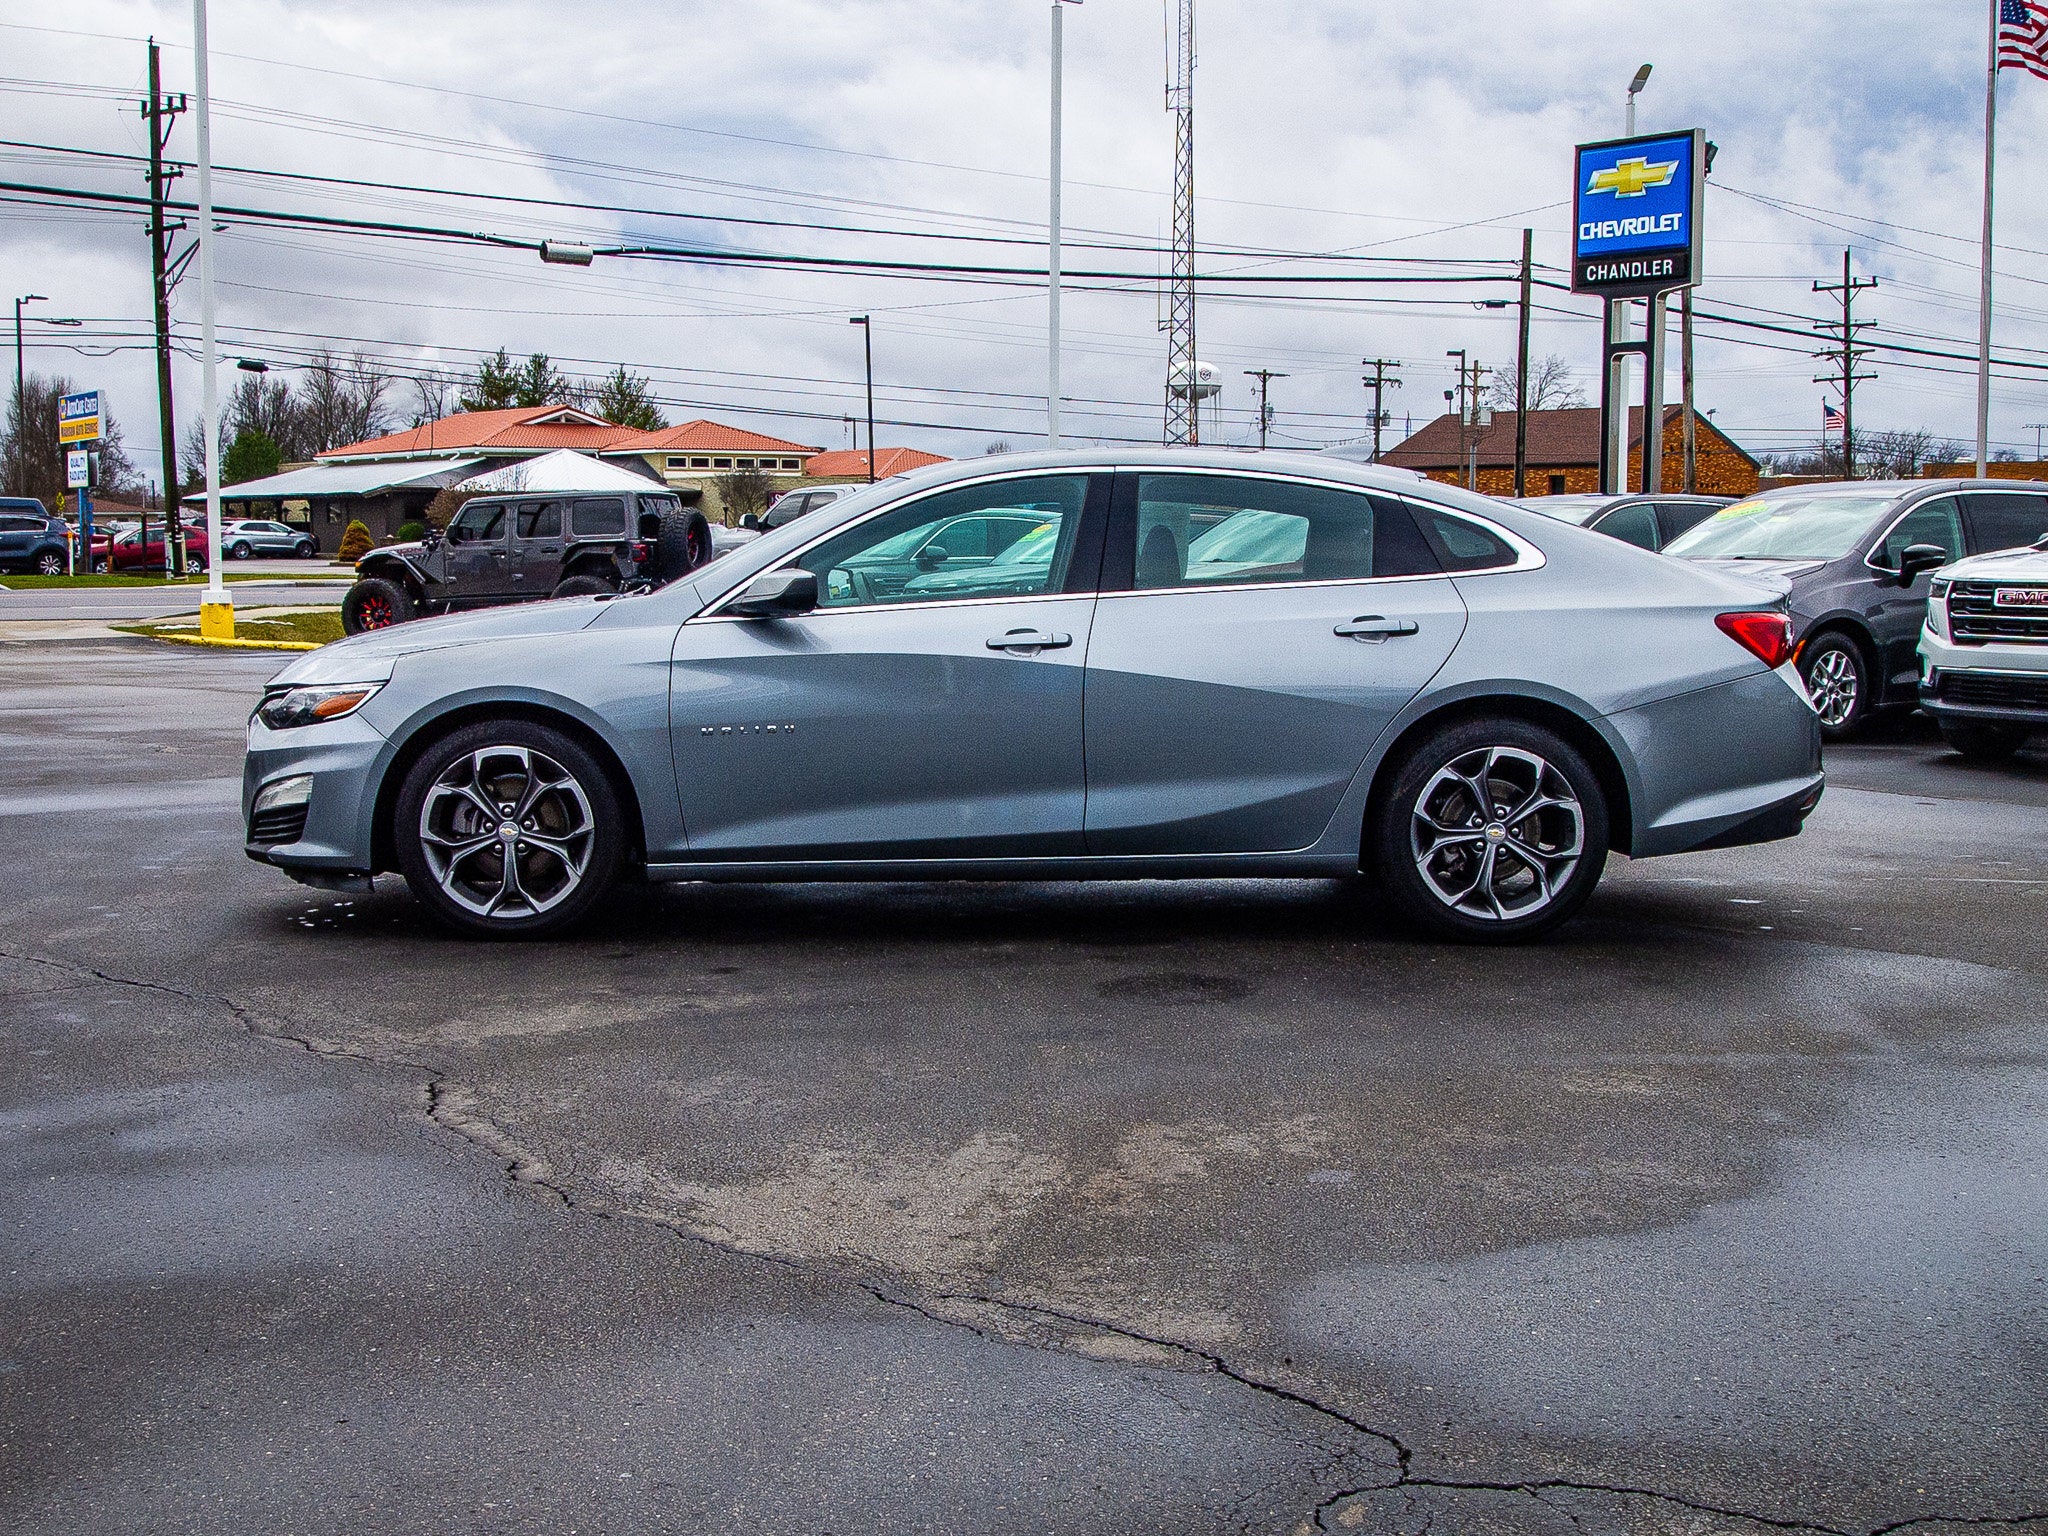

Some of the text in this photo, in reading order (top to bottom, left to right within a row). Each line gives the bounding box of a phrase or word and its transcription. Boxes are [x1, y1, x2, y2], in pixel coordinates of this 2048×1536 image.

[1579, 213, 1682, 240] CHEVROLET
[1586, 259, 1673, 281] CHANDLER
[70, 457, 85, 468] QUALITY
[700, 724, 795, 737] MALIBU
